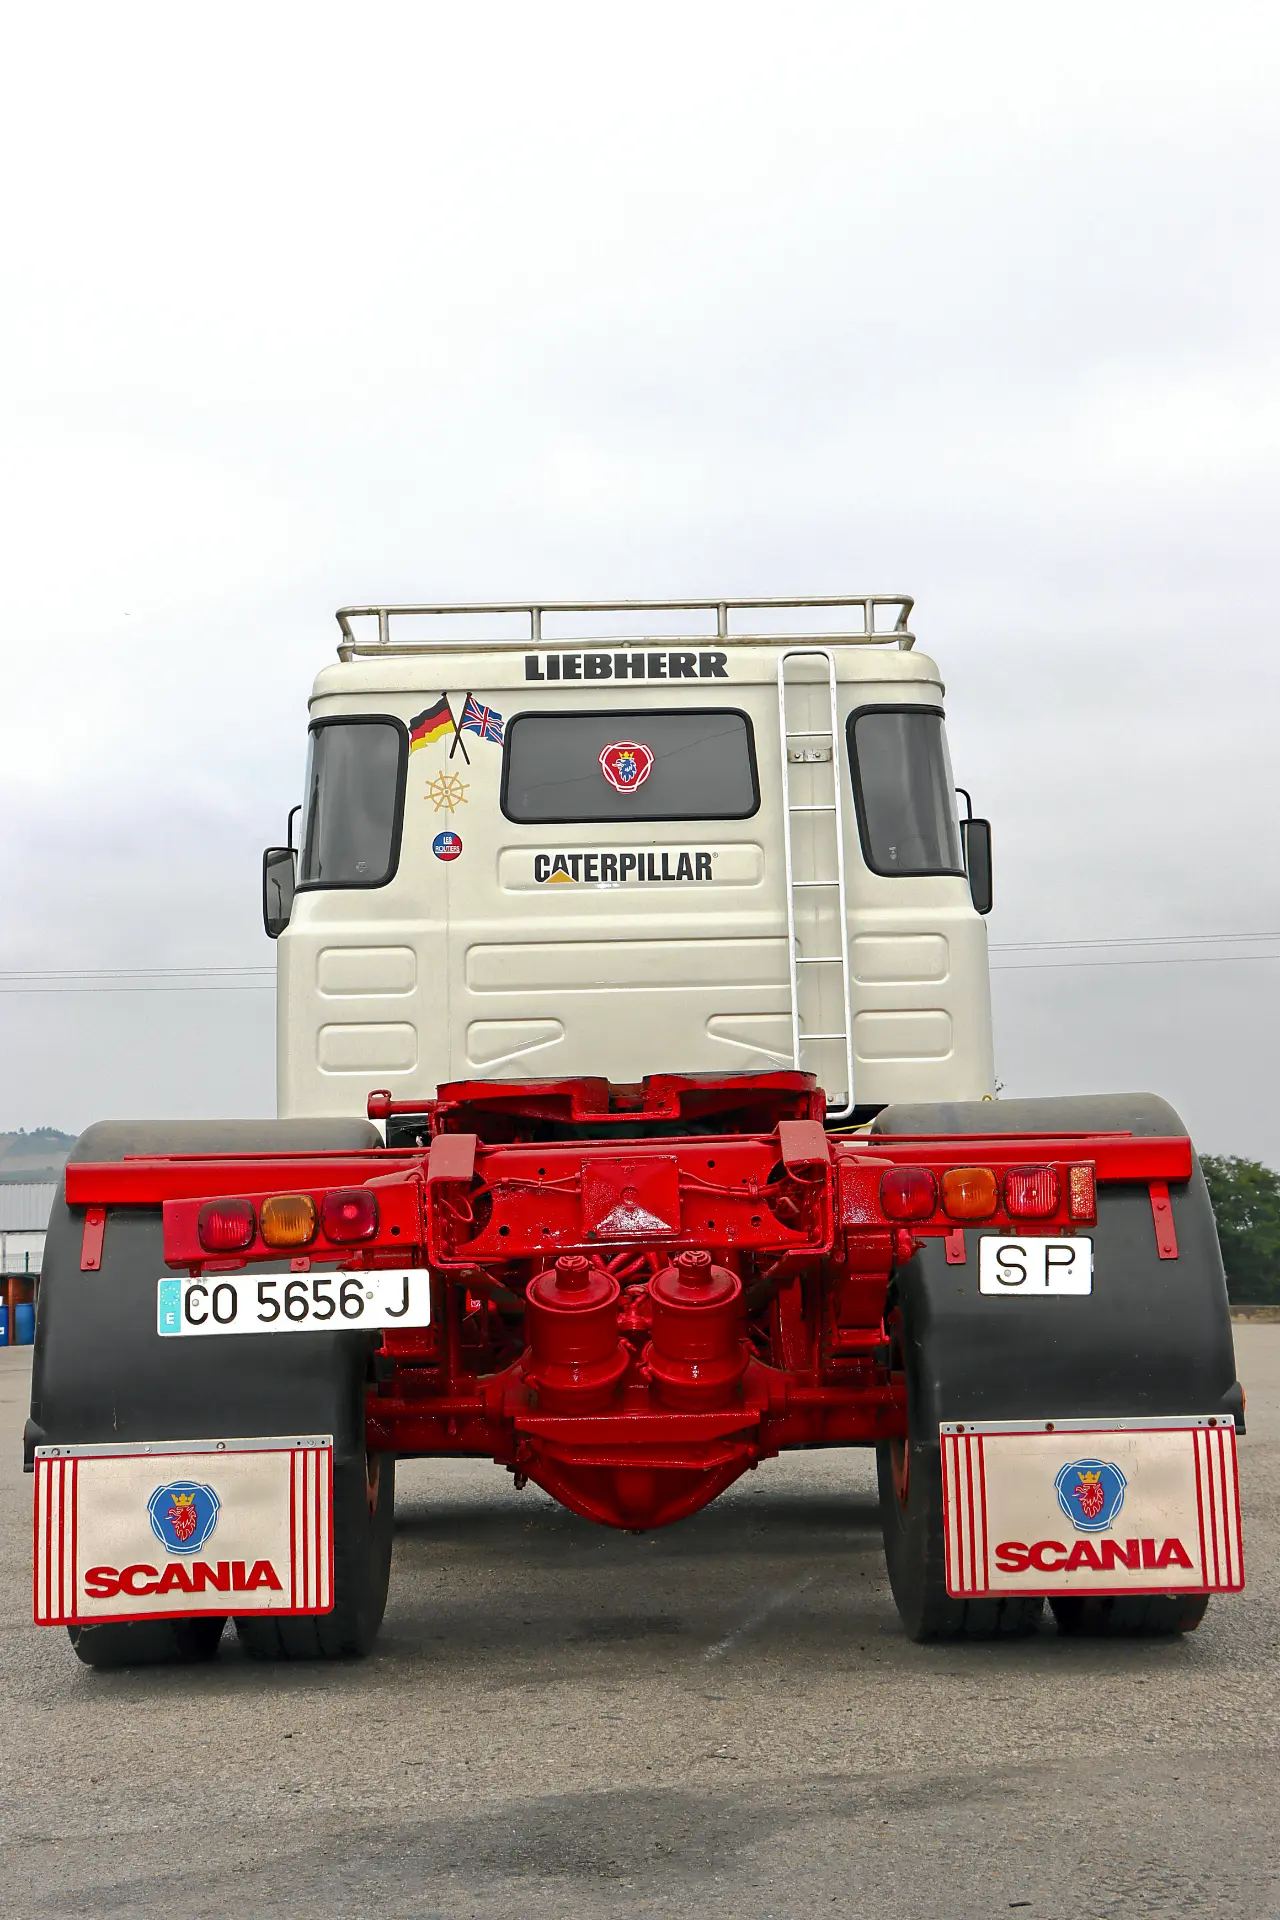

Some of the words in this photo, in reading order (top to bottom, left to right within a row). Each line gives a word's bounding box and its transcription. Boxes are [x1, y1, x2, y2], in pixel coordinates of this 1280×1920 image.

[525, 652, 729, 681] LIEBHERR
[443, 836, 453, 845] LES
[534, 852, 713, 883] CATERPILLAR
[256, 1278, 365, 1323] 5656
[384, 1276, 410, 1318] J
[165, 1312, 175, 1325] E
[994, 1538, 1195, 1573] SCANIA
[84, 1559, 284, 1599] SCANIA
